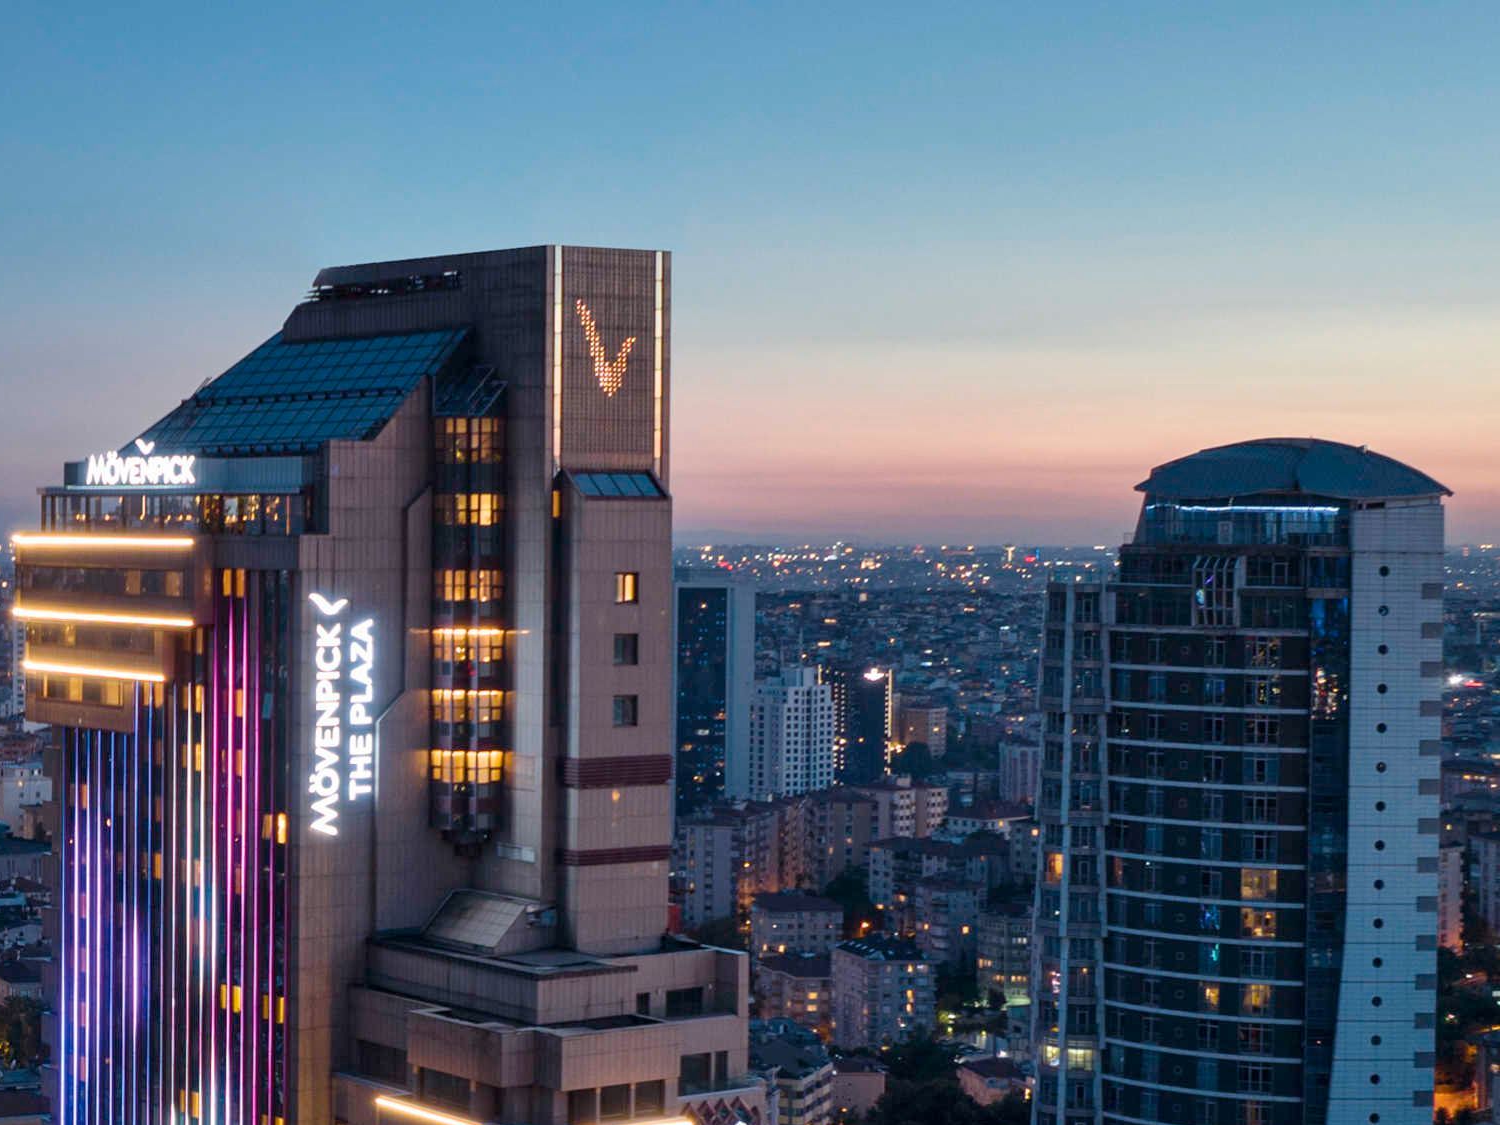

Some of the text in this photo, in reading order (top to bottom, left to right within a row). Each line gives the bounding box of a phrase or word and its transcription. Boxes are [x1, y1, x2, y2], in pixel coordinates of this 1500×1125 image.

[85, 450, 196, 485] MÖVENPICK
[308, 622, 342, 836] MÖVENPICK
[349, 618, 374, 800] THE PLAZA
